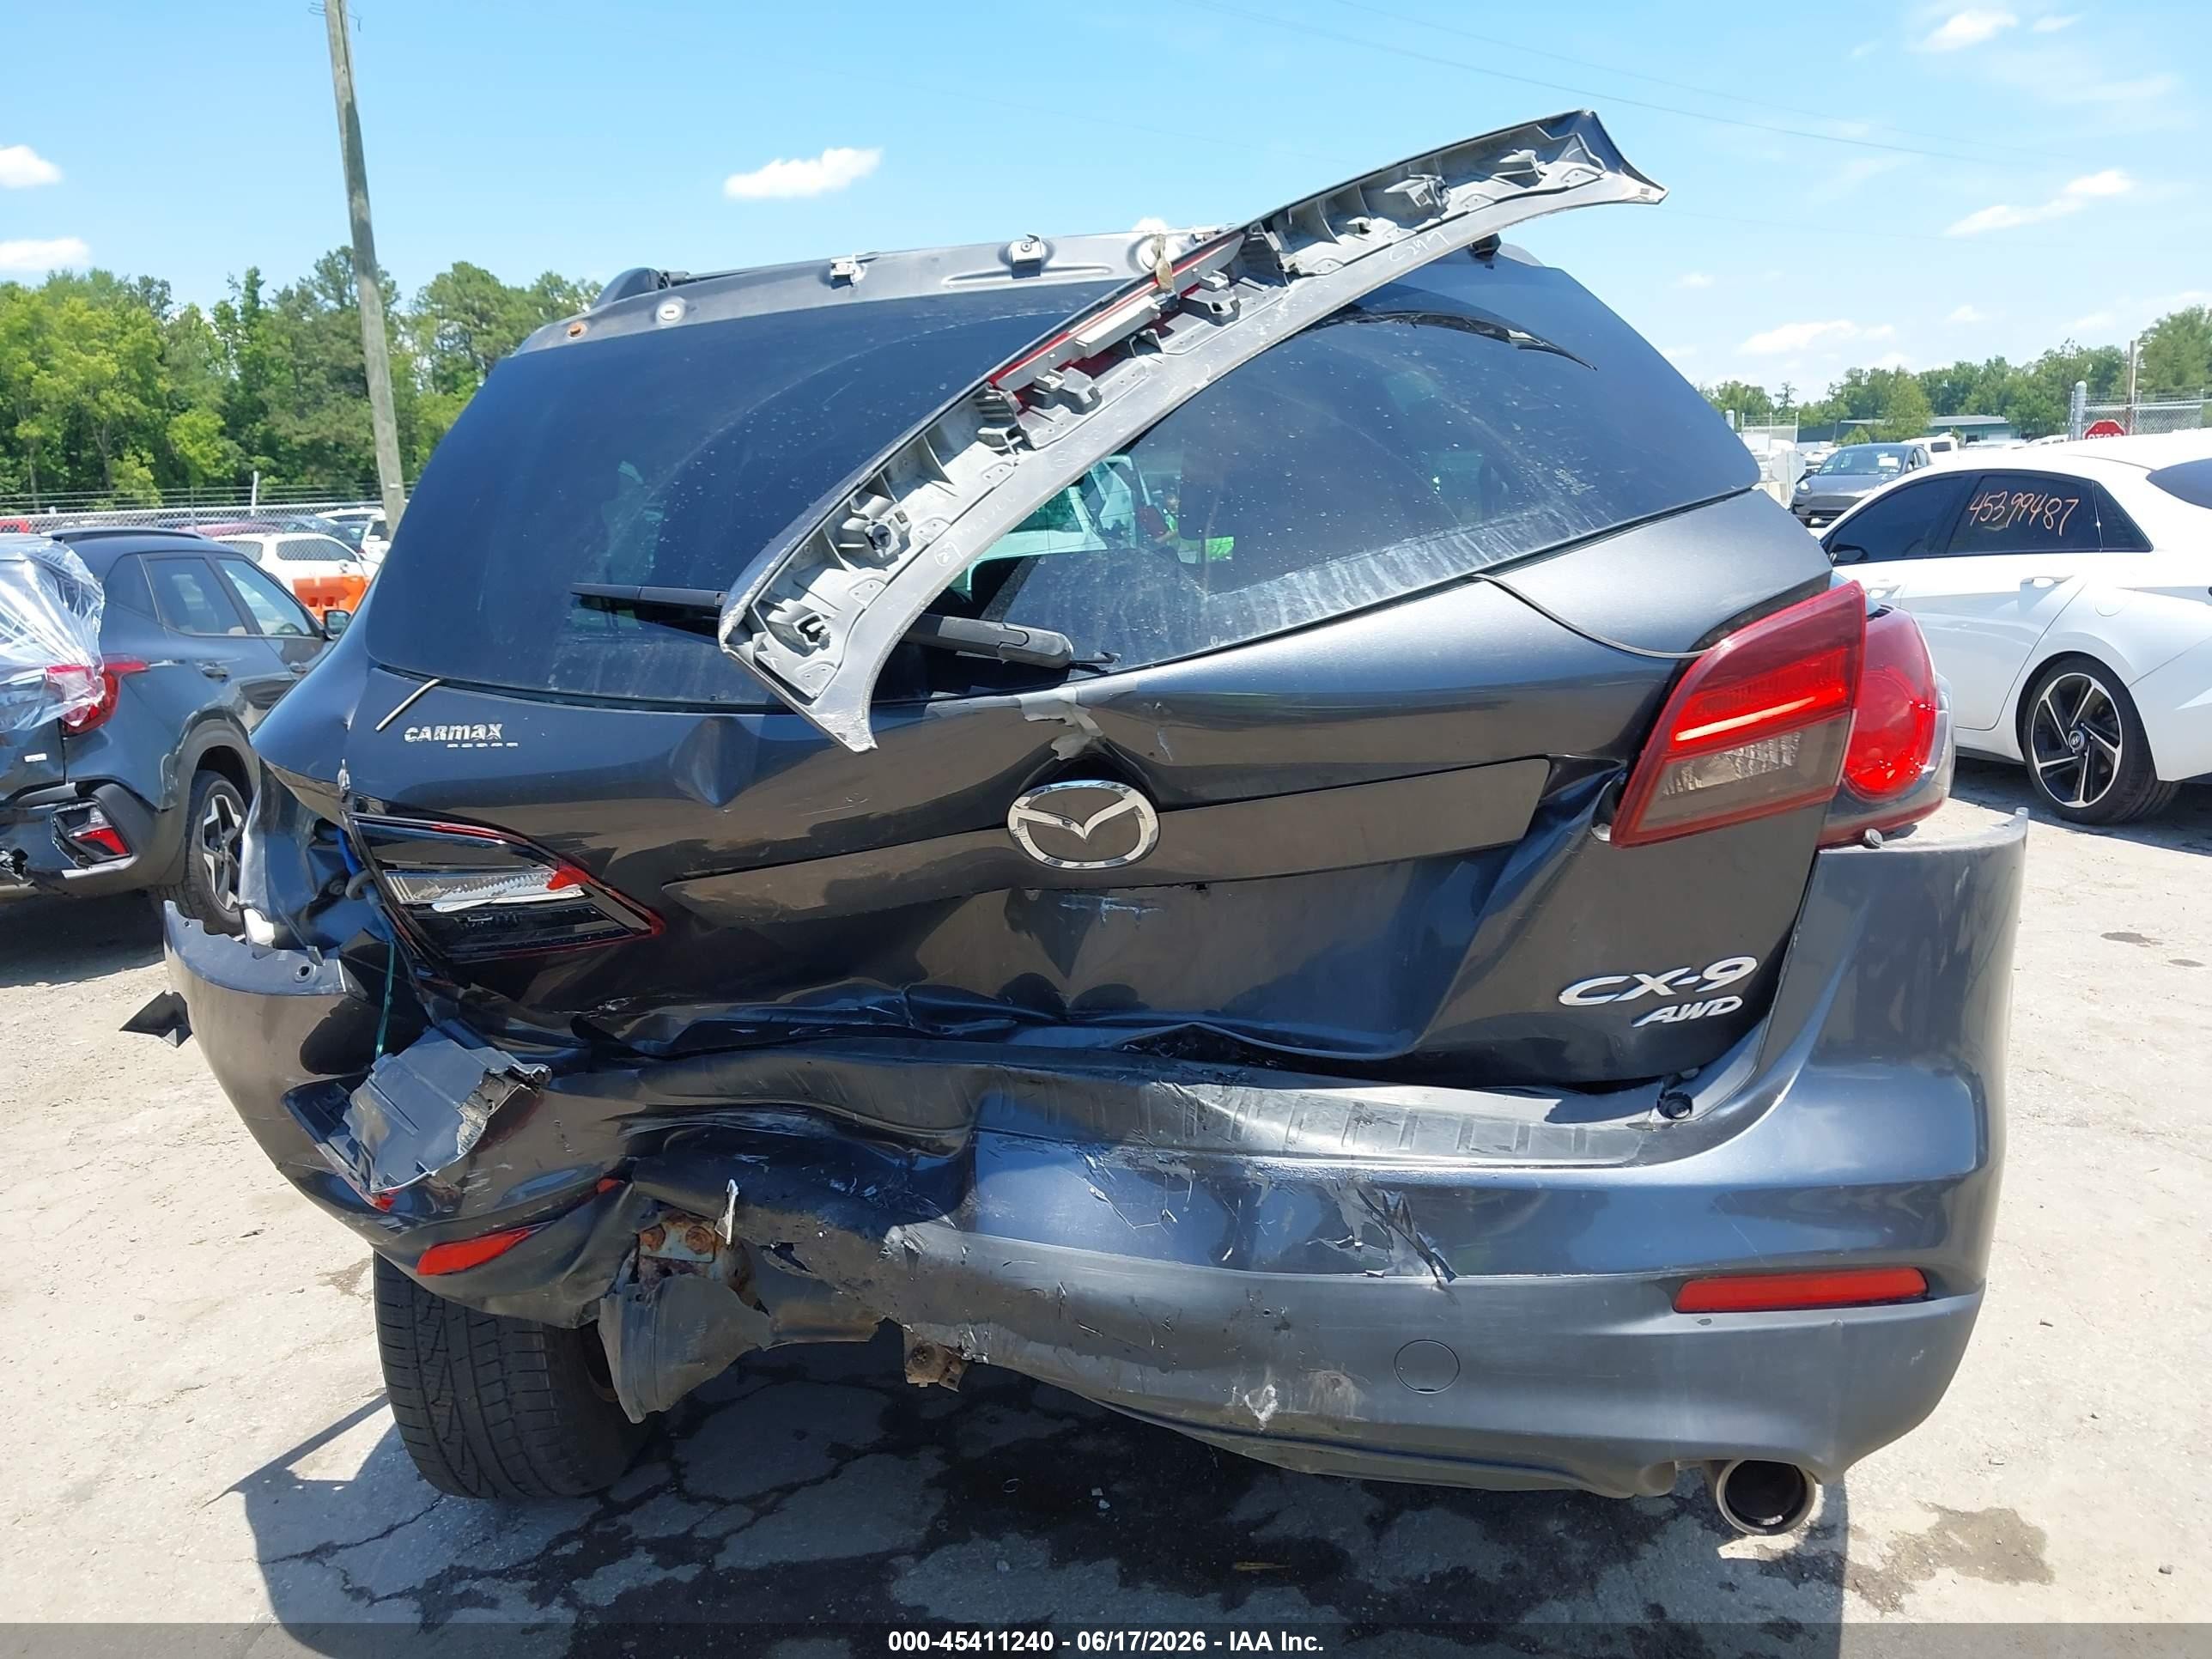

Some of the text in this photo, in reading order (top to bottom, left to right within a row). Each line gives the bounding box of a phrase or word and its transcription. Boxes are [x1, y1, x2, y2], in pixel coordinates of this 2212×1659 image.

[1969, 490, 2080, 537] 45399487
[1558, 956, 1758, 1006] CX-9
[1632, 995, 1743, 1028] AWD
